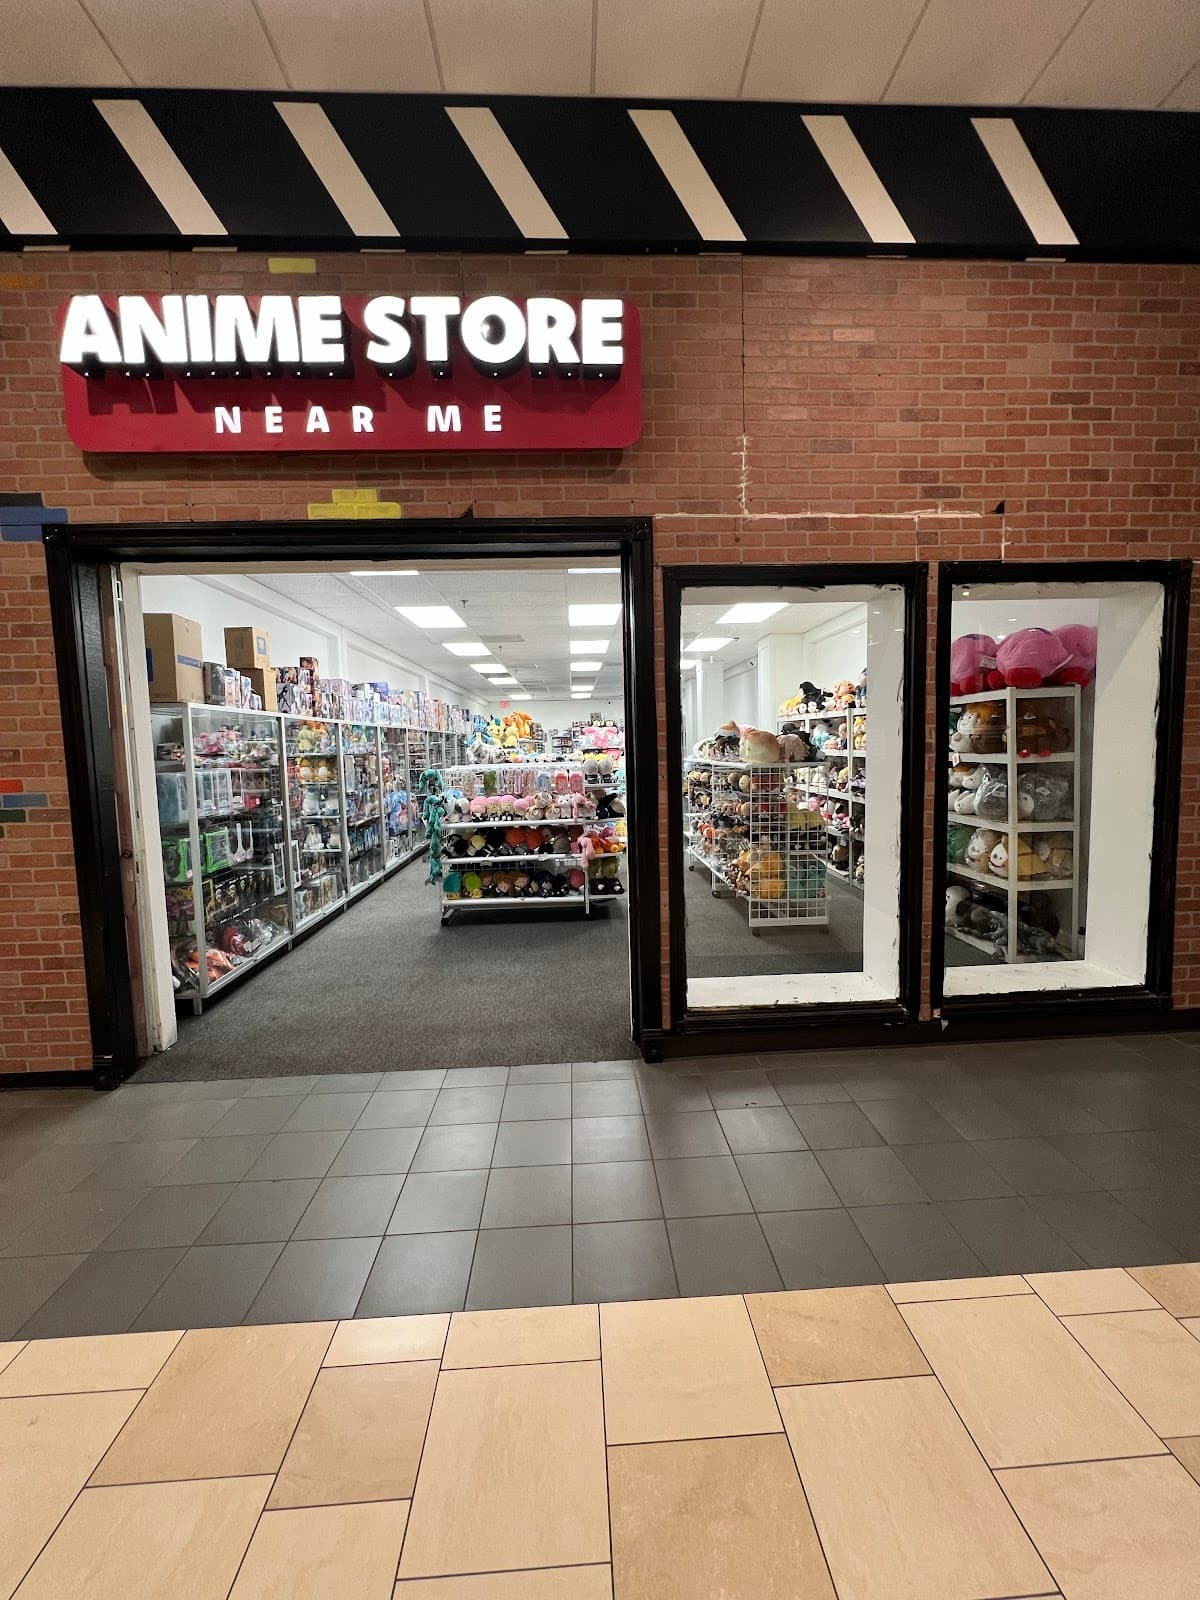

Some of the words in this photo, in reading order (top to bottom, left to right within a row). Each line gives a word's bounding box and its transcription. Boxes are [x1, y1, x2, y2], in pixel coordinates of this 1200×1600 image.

[60, 295, 344, 365] ANIME
[365, 295, 623, 365] STORE
[214, 405, 375, 434] NEAR
[427, 404, 503, 433] ME
